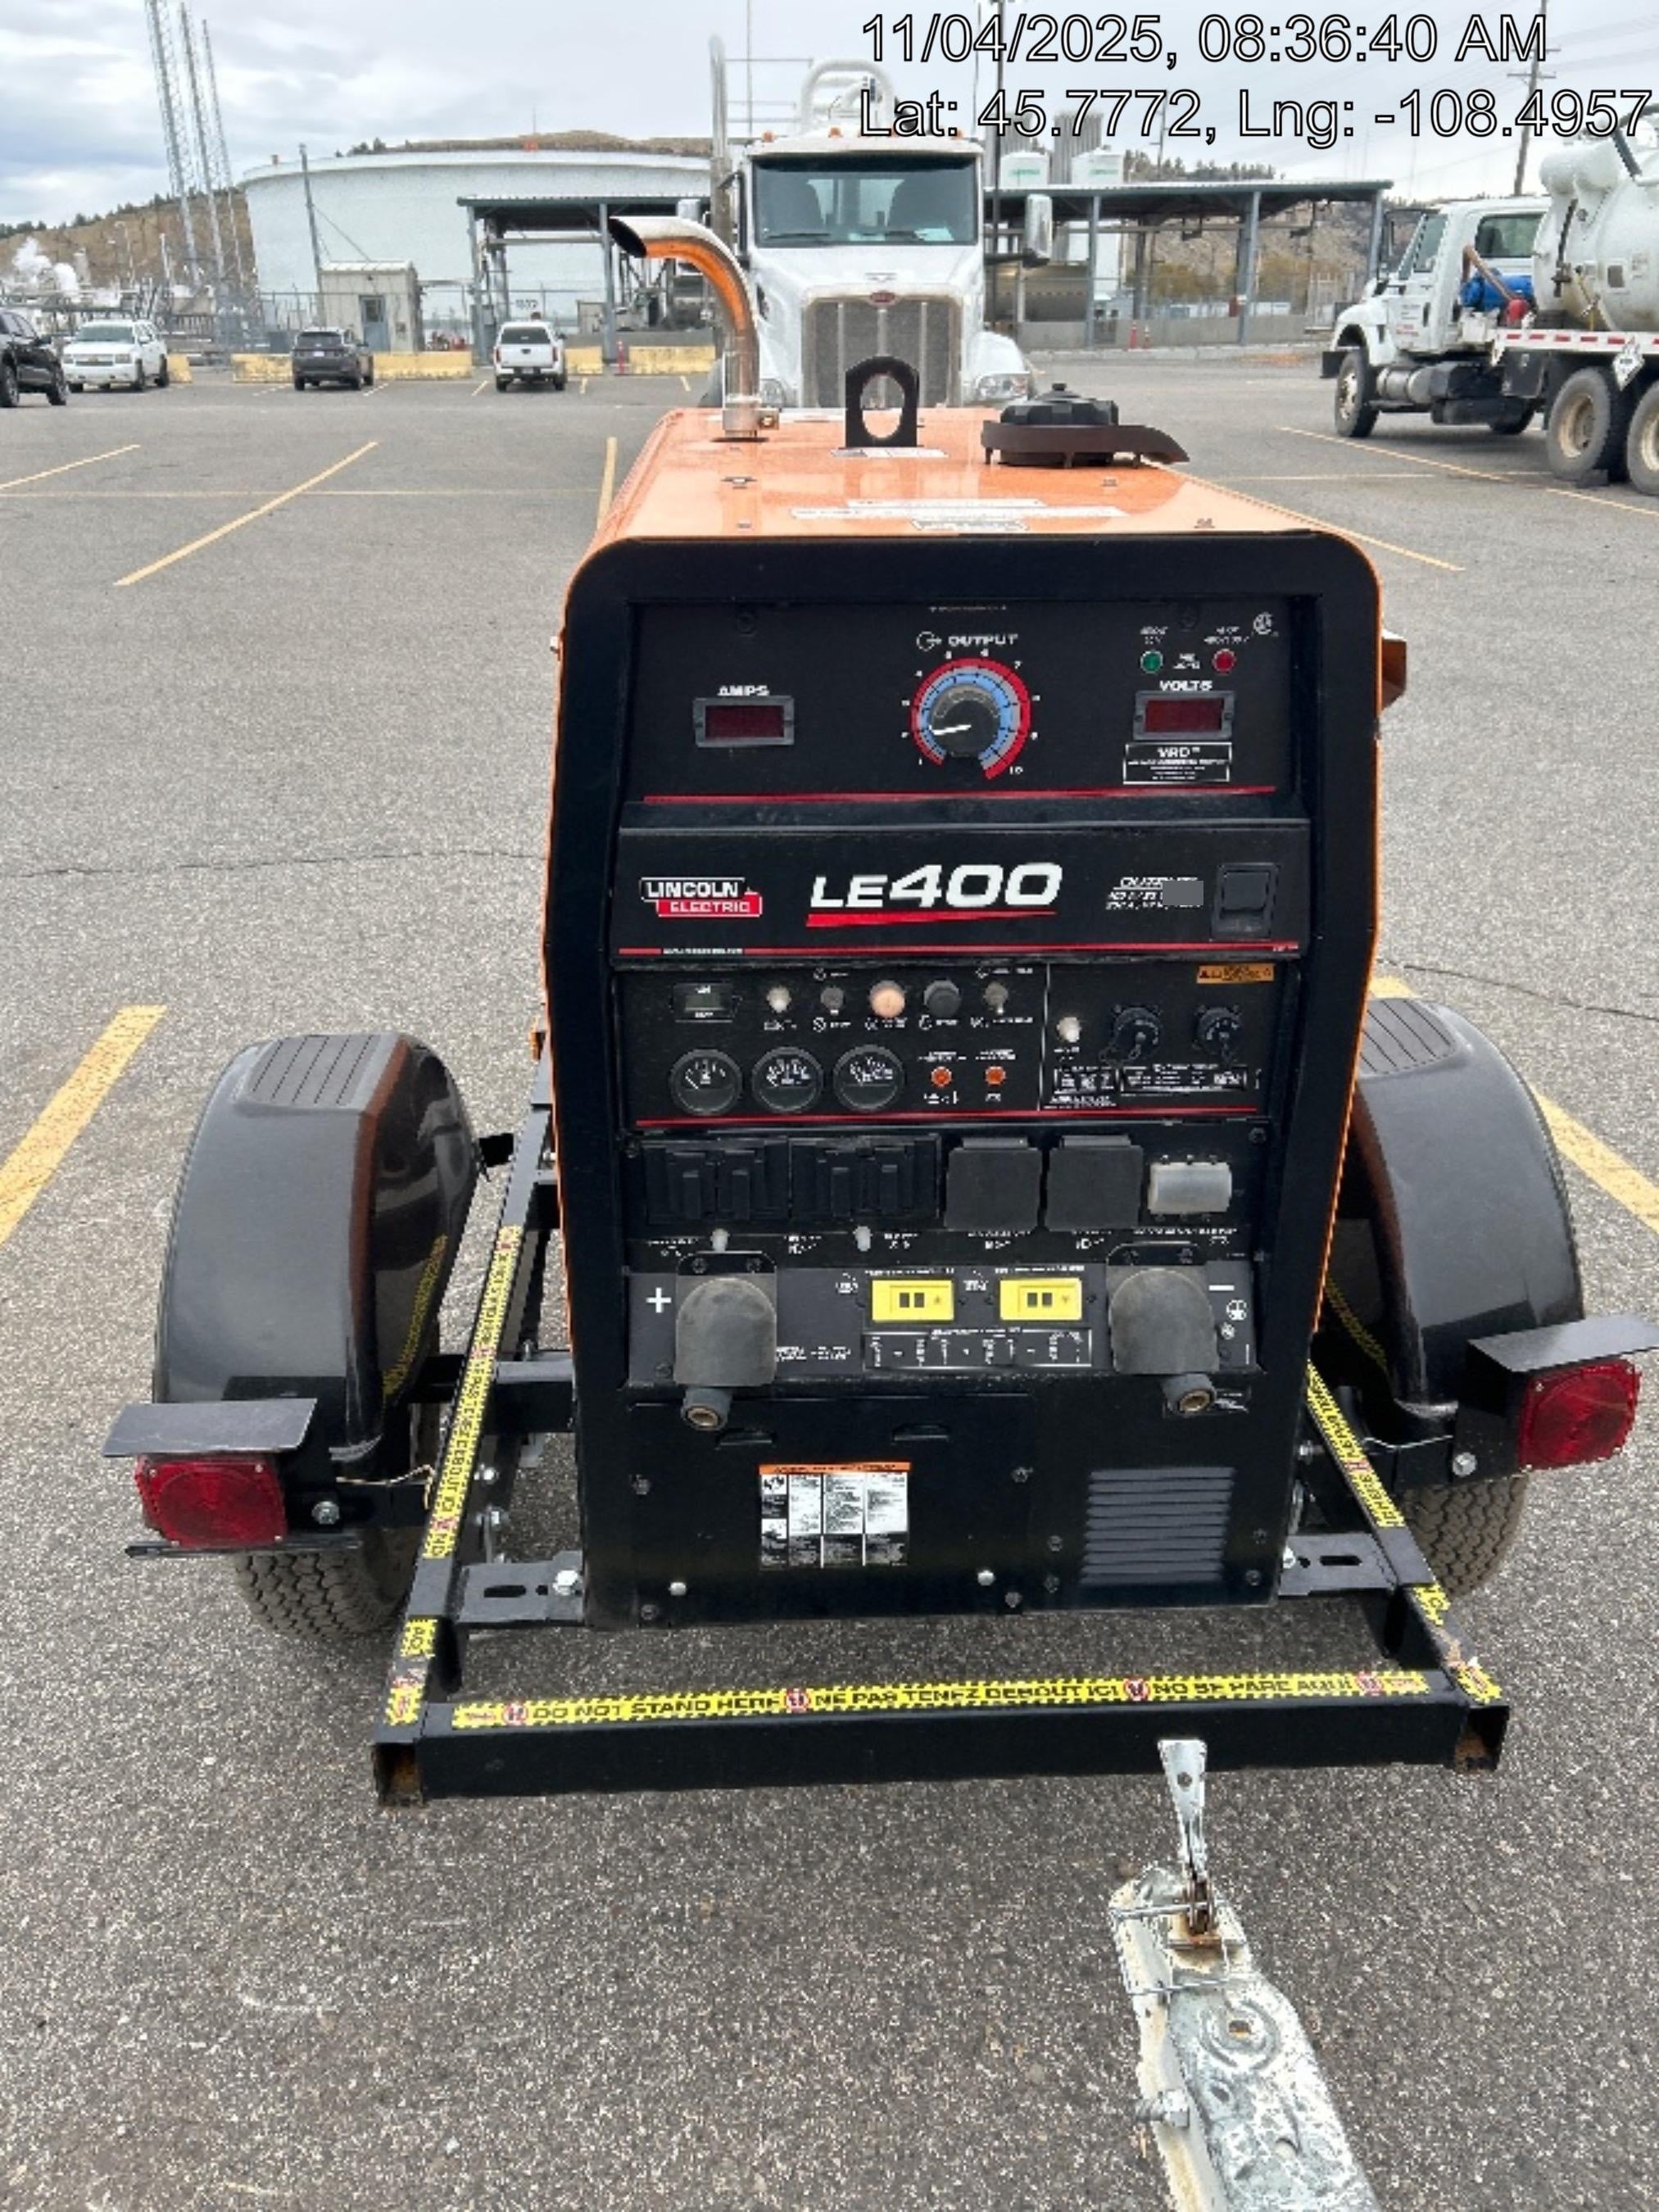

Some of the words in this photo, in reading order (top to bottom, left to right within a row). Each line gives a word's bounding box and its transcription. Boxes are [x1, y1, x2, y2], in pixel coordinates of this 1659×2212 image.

[947, 633, 1019, 647] OUTPUT
[717, 684, 771, 696] AMPS
[1159, 680, 1213, 691] VOLTS
[646, 882, 739, 898] LINCOLN
[809, 862, 1063, 908] LE400
[669, 901, 751, 913] ELECTRIC
[1154, 1682, 1189, 1695] NO
[815, 1693, 847, 1706] NE
[533, 1707, 569, 1720] DO
[574, 1704, 623, 1717] NOT
[630, 1700, 711, 1715] STAND
